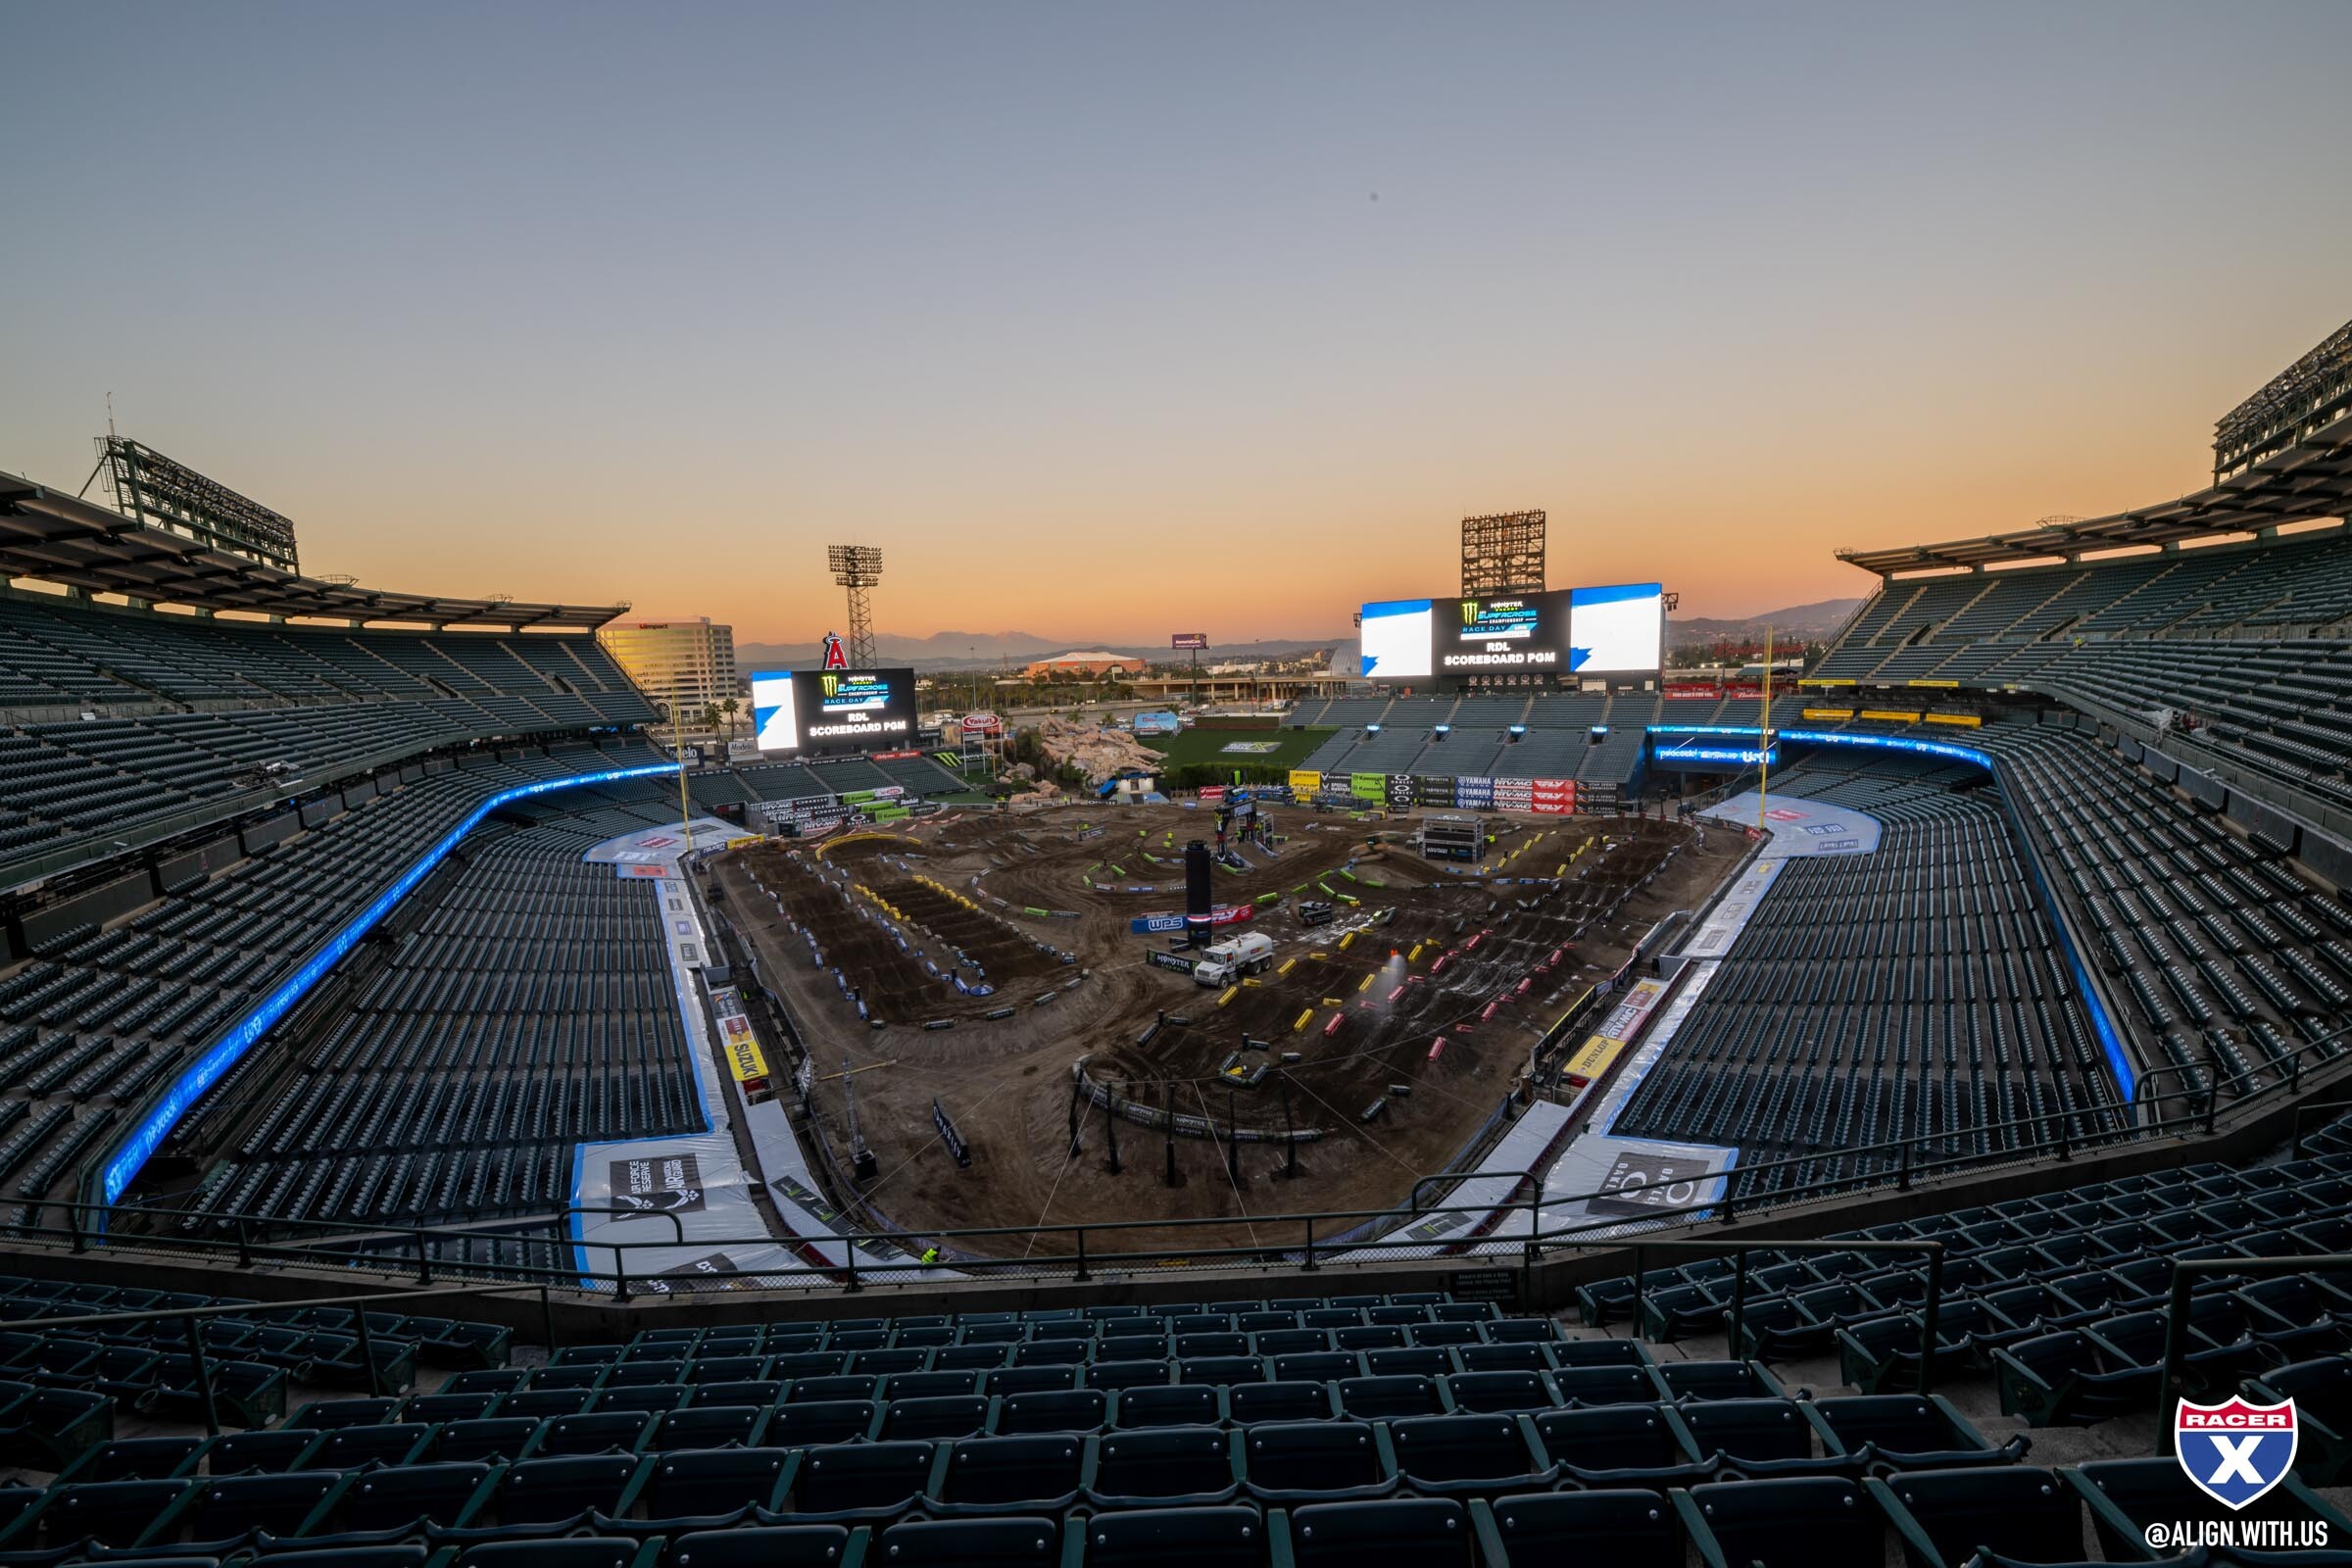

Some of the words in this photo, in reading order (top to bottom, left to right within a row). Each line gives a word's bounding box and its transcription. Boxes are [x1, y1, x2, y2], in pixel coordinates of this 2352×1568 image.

[1486, 641, 1510, 653] RDL
[1444, 654, 1525, 666] SCOREBOARD
[1527, 652, 1556, 663] PGM
[848, 712, 869, 722] RDL
[809, 723, 882, 737] SCOREBOARD
[883, 720, 906, 731] PGM
[1148, 917, 1183, 931] WPS
[1156, 954, 1191, 969] MONSTER
[734, 1043, 760, 1079] SUZUKI
[1581, 1039, 1609, 1068] DUNLOP
[629, 1160, 641, 1184] FORCE
[671, 1159, 684, 1176] GUARD
[640, 1161, 653, 1193] RESERVE
[664, 1176, 685, 1190] AIR
[1644, 1168, 1674, 1204] OALE
